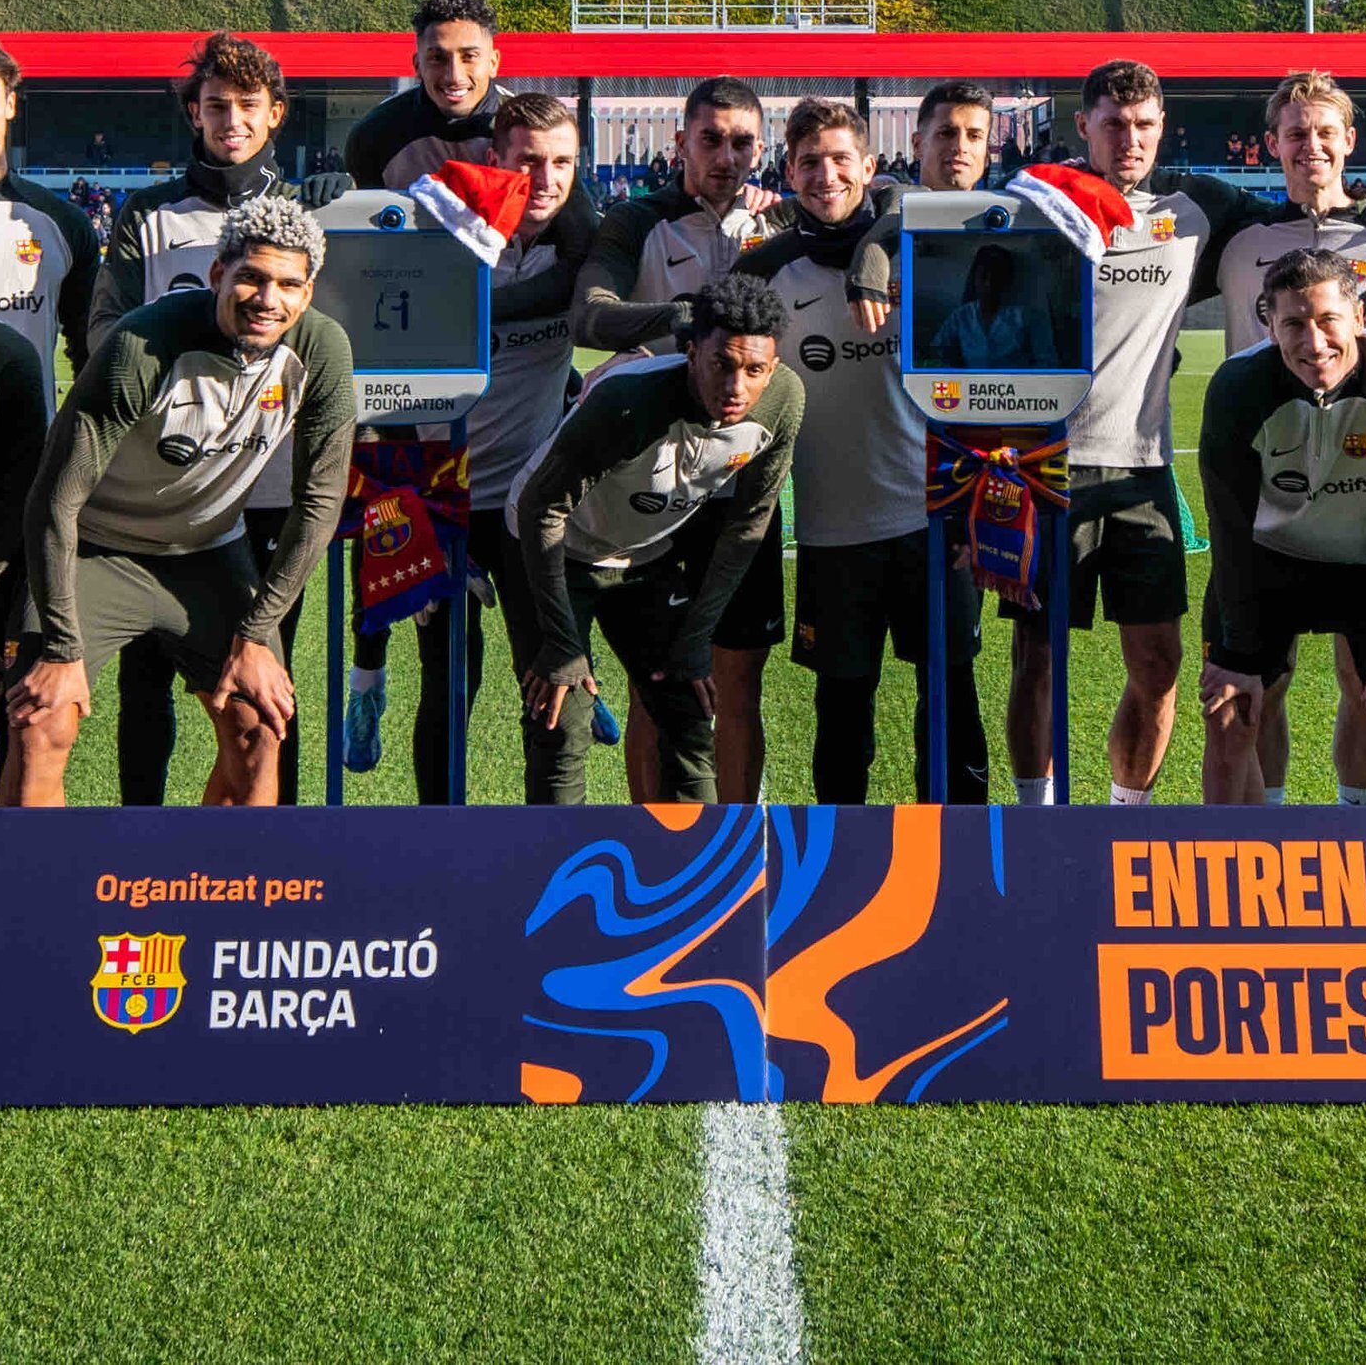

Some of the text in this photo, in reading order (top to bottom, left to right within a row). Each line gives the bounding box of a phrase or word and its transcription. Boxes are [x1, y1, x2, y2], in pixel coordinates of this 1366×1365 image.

[1098, 265, 1172, 286] Spotify
[841, 335, 902, 362] Spoti
[365, 384, 411, 398] BARÇA
[969, 384, 1015, 397] BARÇA
[365, 398, 455, 411] FOUNDATION
[969, 398, 1058, 411] FOUNDATION
[96, 872, 325, 908] Organitzat per:
[213, 928, 438, 979] FUNDACIÓ
[121, 975, 156, 987] FCB
[209, 990, 356, 1036] BARÇA
